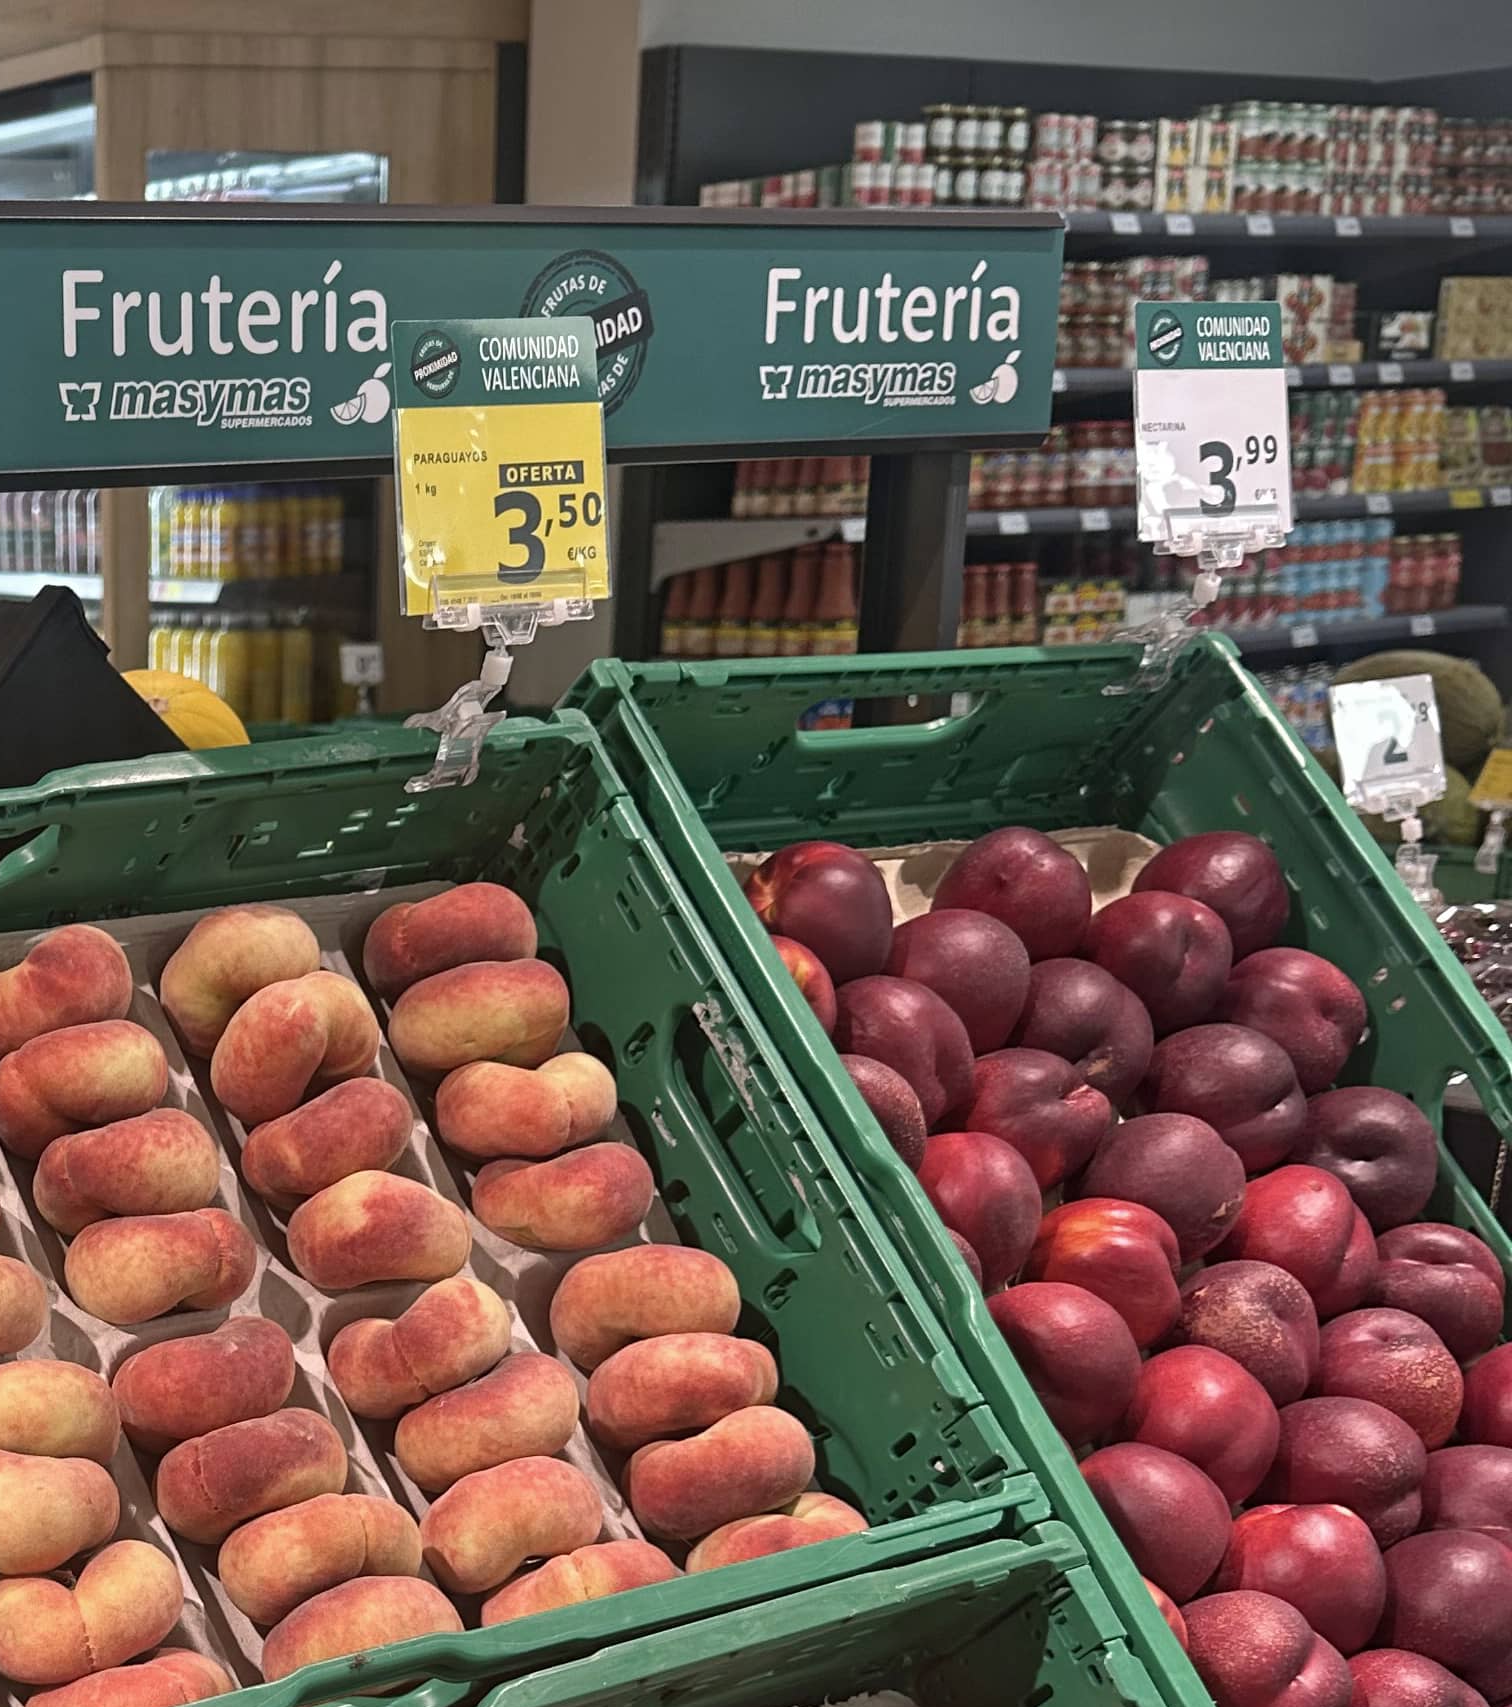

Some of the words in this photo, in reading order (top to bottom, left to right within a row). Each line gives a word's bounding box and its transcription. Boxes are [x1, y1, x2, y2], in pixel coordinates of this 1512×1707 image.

[62, 259, 387, 358] Frutería
[540, 274, 585, 319] FRUTAS
[588, 275, 607, 295] DE
[765, 259, 1021, 344] Frutería
[1197, 317, 1270, 337] COMUNIDAD
[479, 335, 579, 362] COMUNIDAD
[1199, 341, 1270, 361] VALENCIANA
[414, 352, 458, 381] PROXIMIDAD
[481, 364, 580, 391] VALENCIANA
[612, 353, 629, 377] DE
[796, 361, 957, 404] masymas
[109, 376, 311, 427] masymas
[220, 415, 313, 429] SUPERMERCADOS
[413, 450, 488, 464] PARAGUAYOS
[506, 464, 576, 483] OFERTA
[425, 483, 437, 496] kg
[567, 546, 597, 561] €/KG
